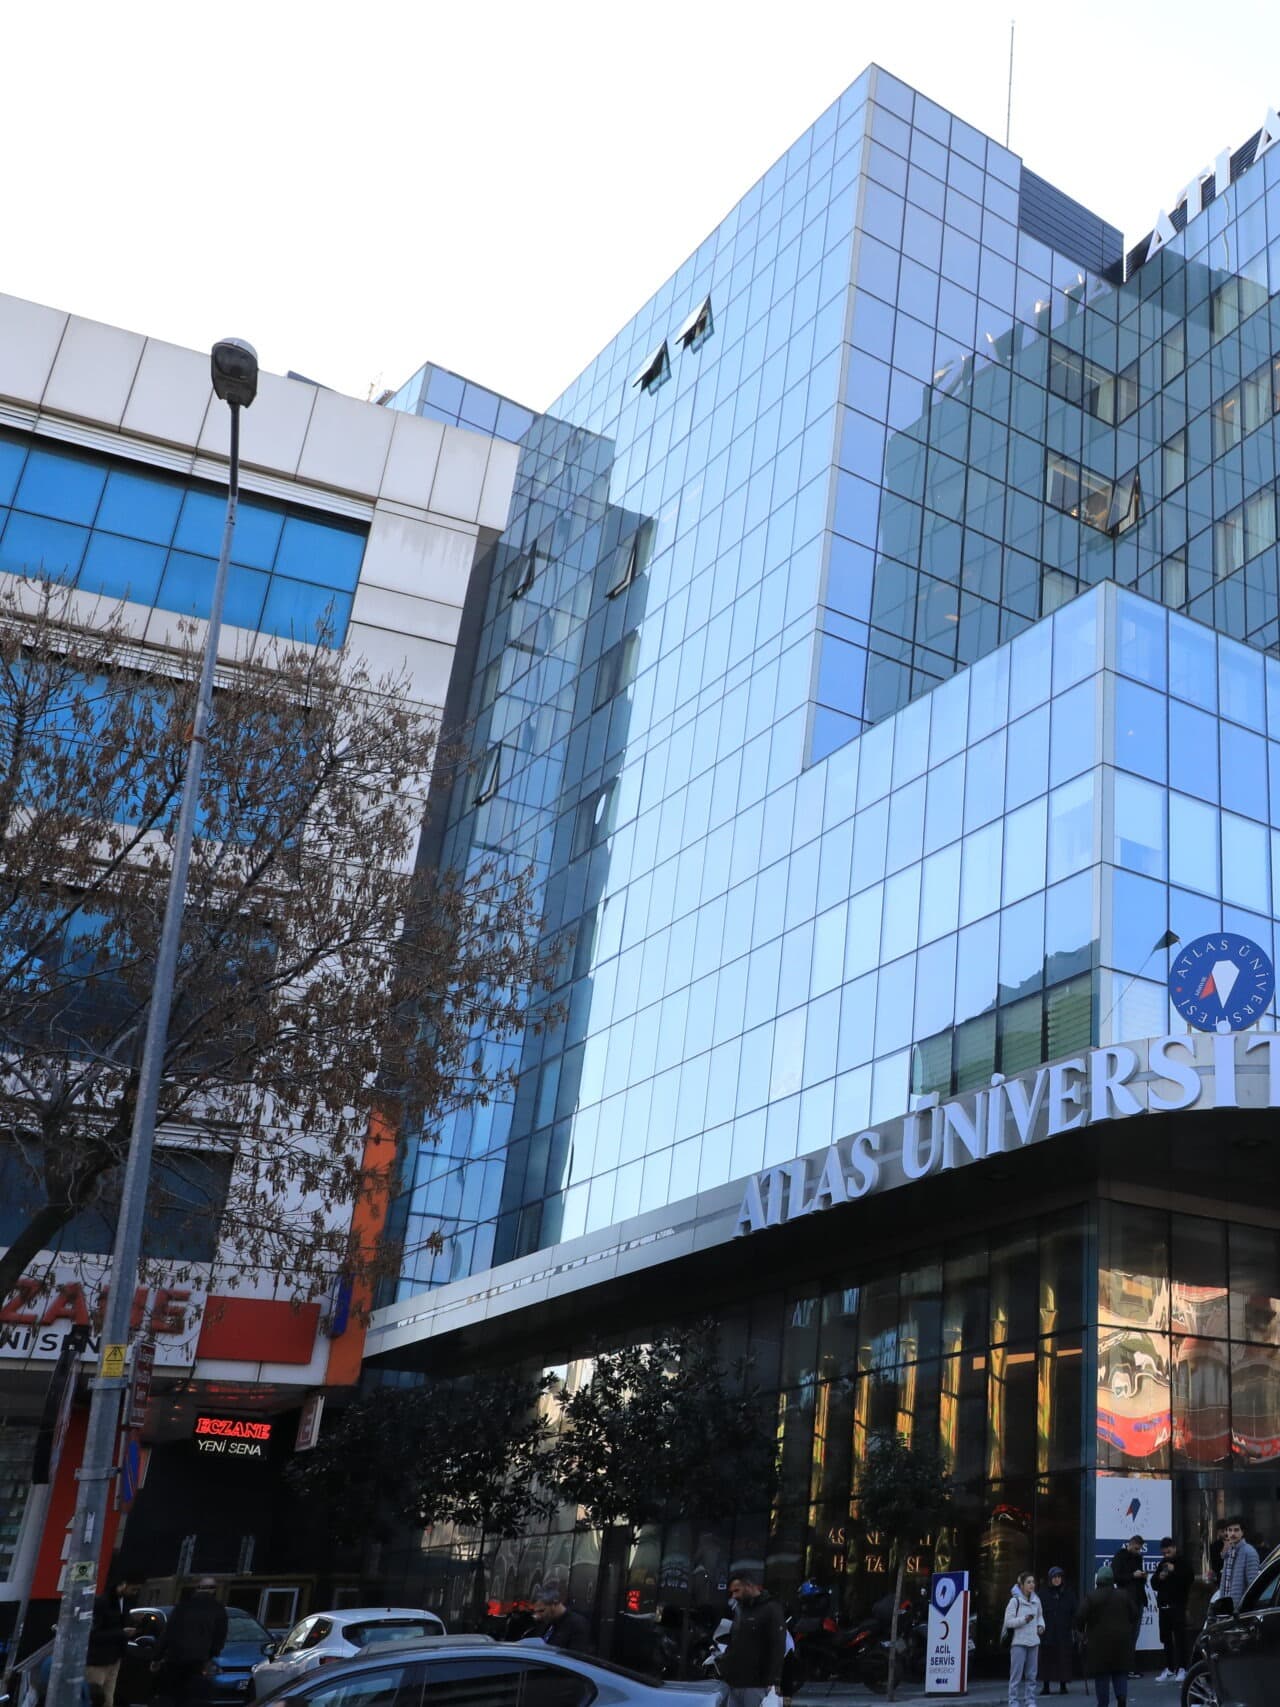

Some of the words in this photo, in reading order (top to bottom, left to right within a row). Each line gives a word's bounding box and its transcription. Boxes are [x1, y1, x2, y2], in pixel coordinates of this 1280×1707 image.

[1177, 940, 1229, 979] ATLAS
[731, 1131, 881, 1239] ATLAS
[195, 1417, 272, 1440] ECZANE
[198, 1438, 227, 1453] YENİ
[228, 1442, 262, 1457] SENA
[934, 1643, 951, 1655] ACİL
[930, 1655, 955, 1667] SERVİS
